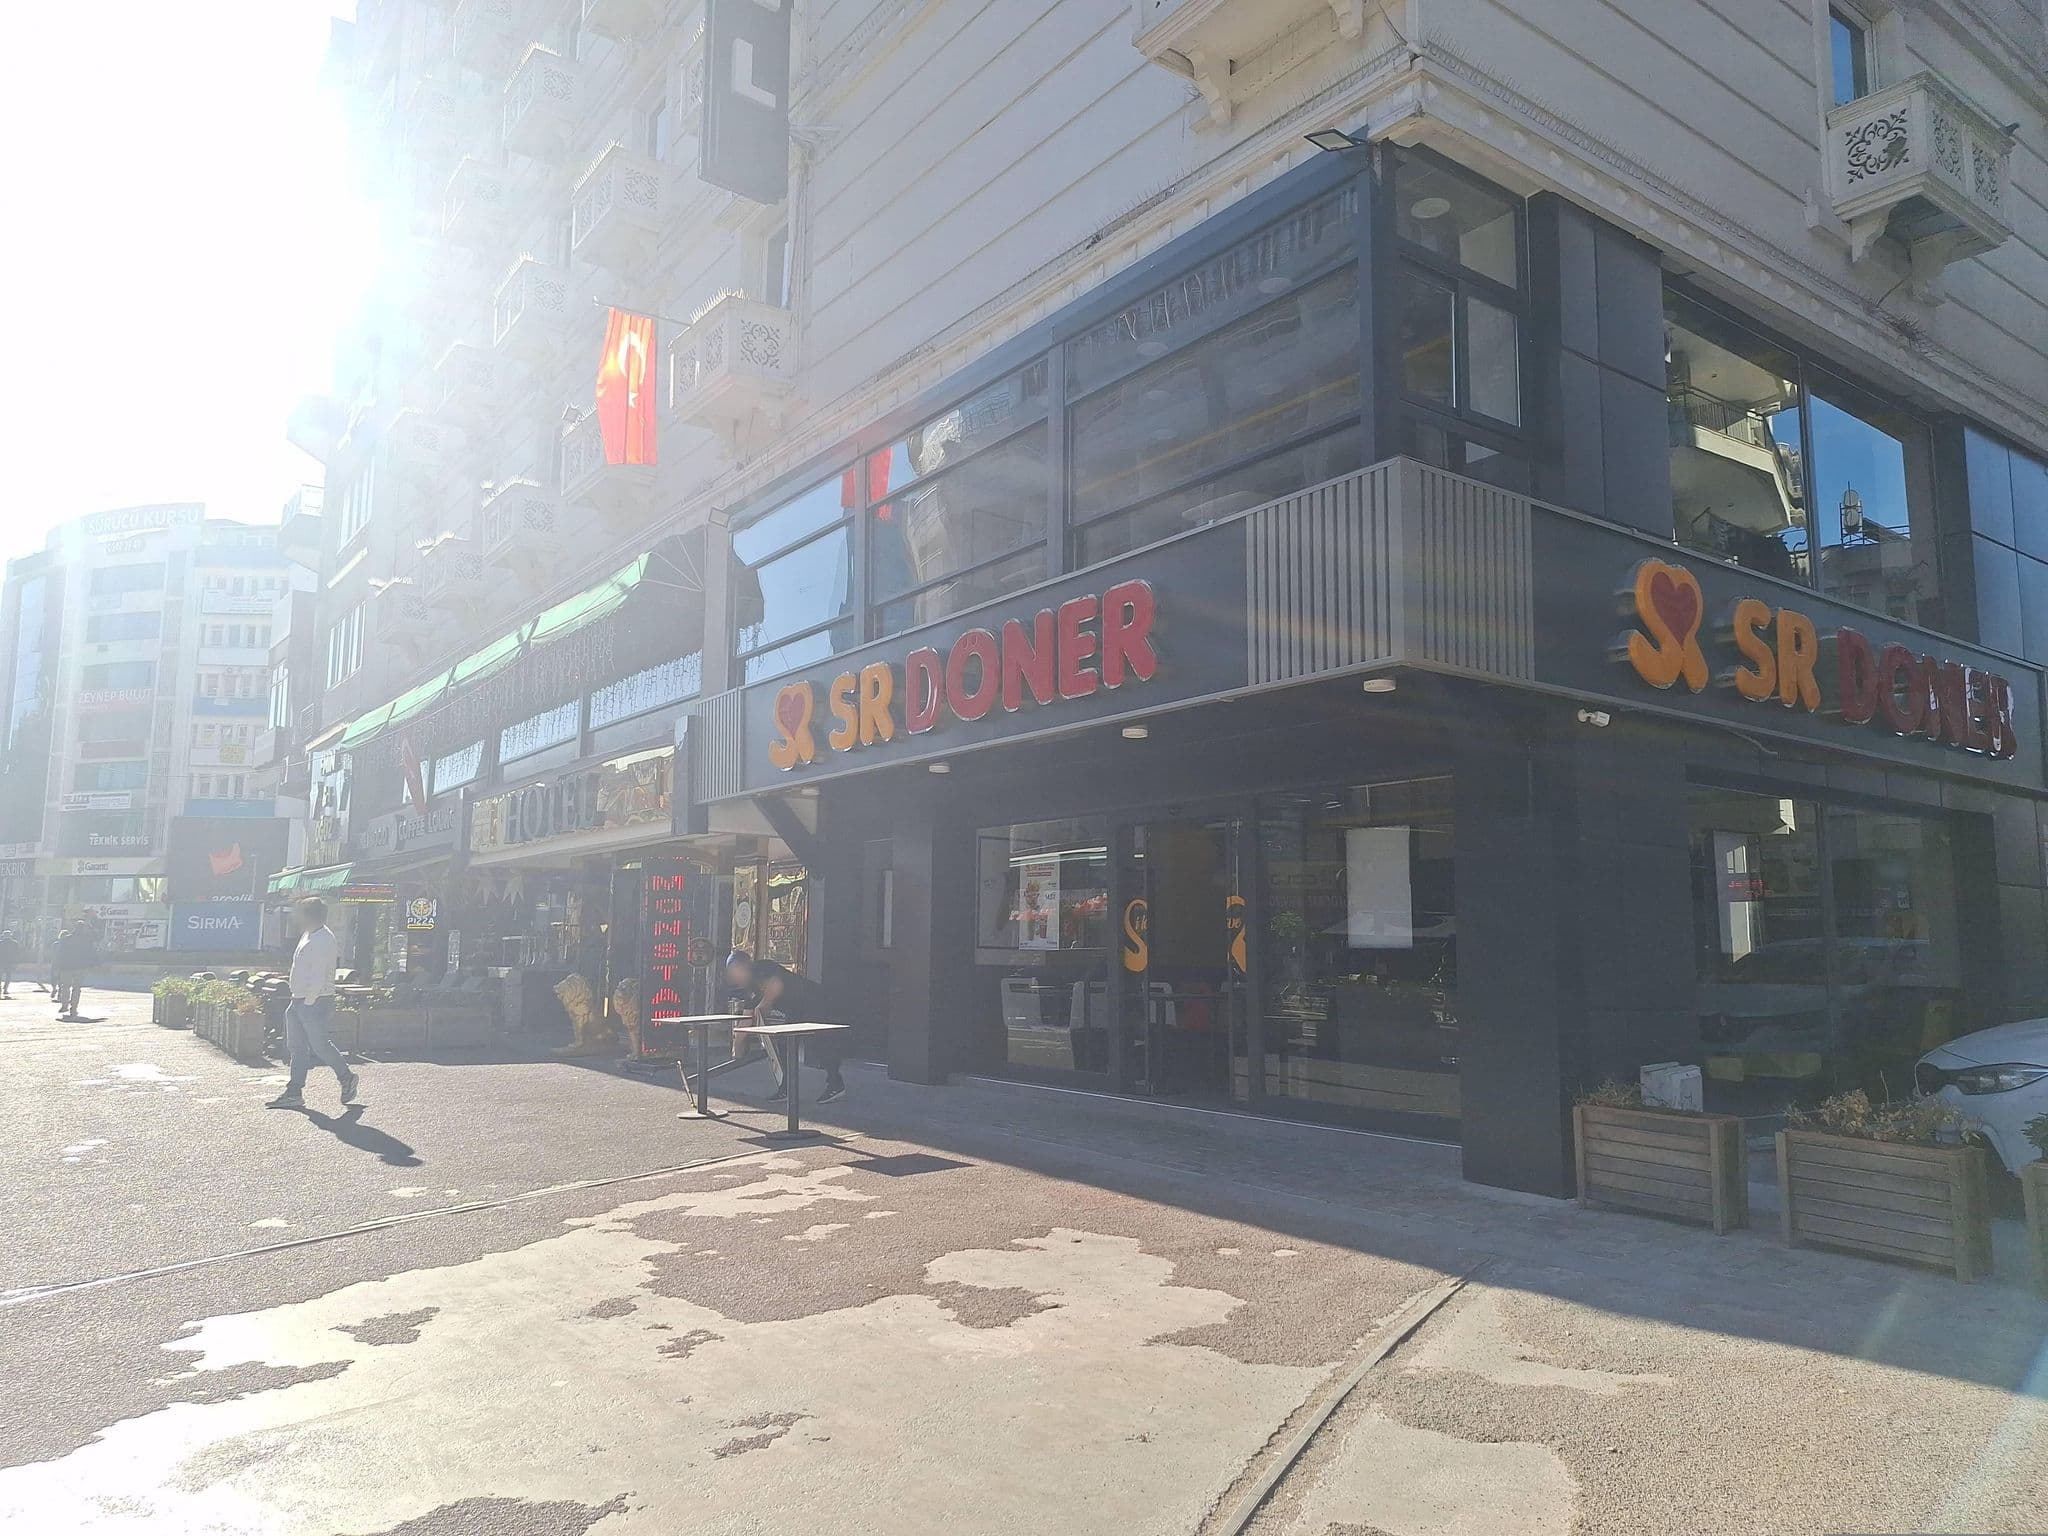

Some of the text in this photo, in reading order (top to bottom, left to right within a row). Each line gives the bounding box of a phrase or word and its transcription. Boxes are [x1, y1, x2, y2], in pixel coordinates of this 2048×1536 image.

[1732, 597, 1822, 713] SR
[829, 661, 895, 753] SR
[407, 917, 435, 925] PIZZA
